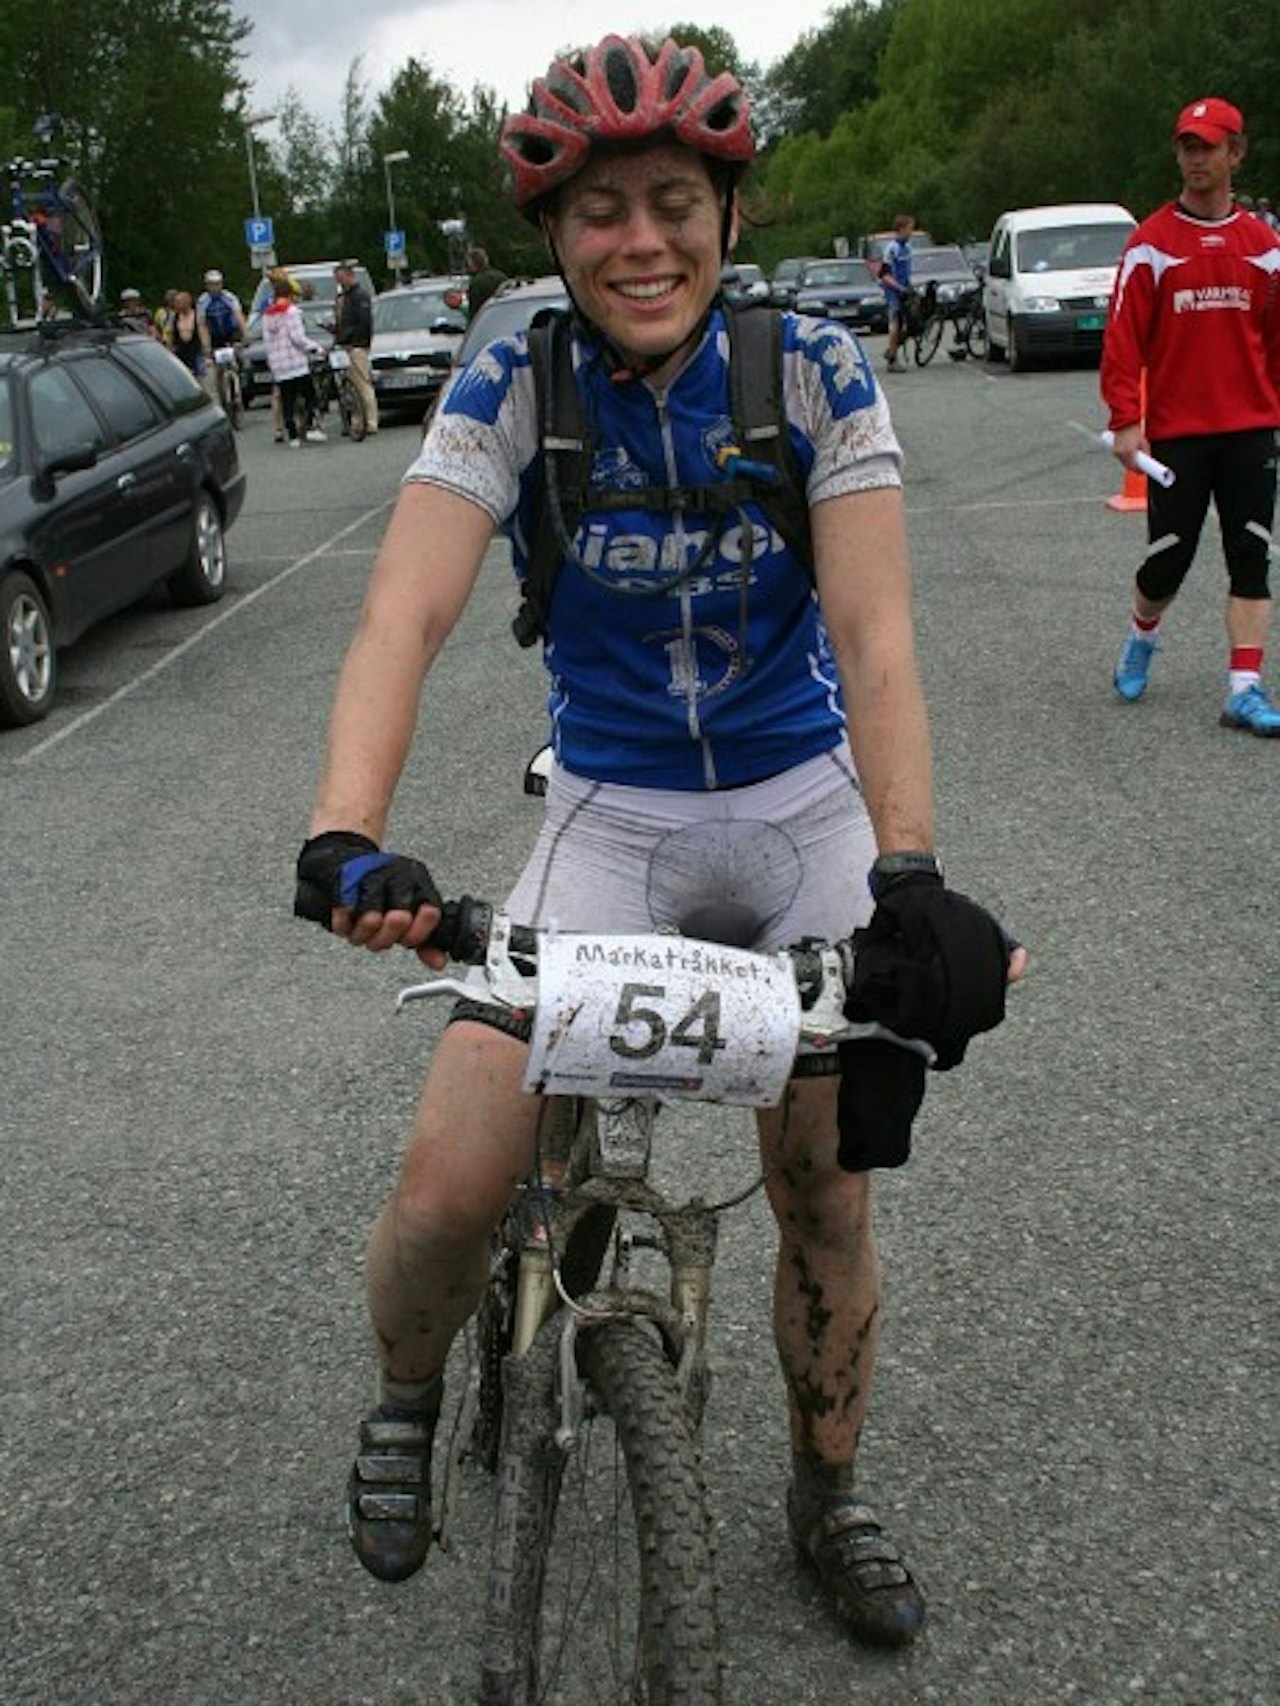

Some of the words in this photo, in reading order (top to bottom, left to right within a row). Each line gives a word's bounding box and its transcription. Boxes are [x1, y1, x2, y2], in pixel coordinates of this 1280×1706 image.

[252, 222, 267, 242] P
[388, 233, 400, 250] P
[609, 982, 727, 1066] 54
